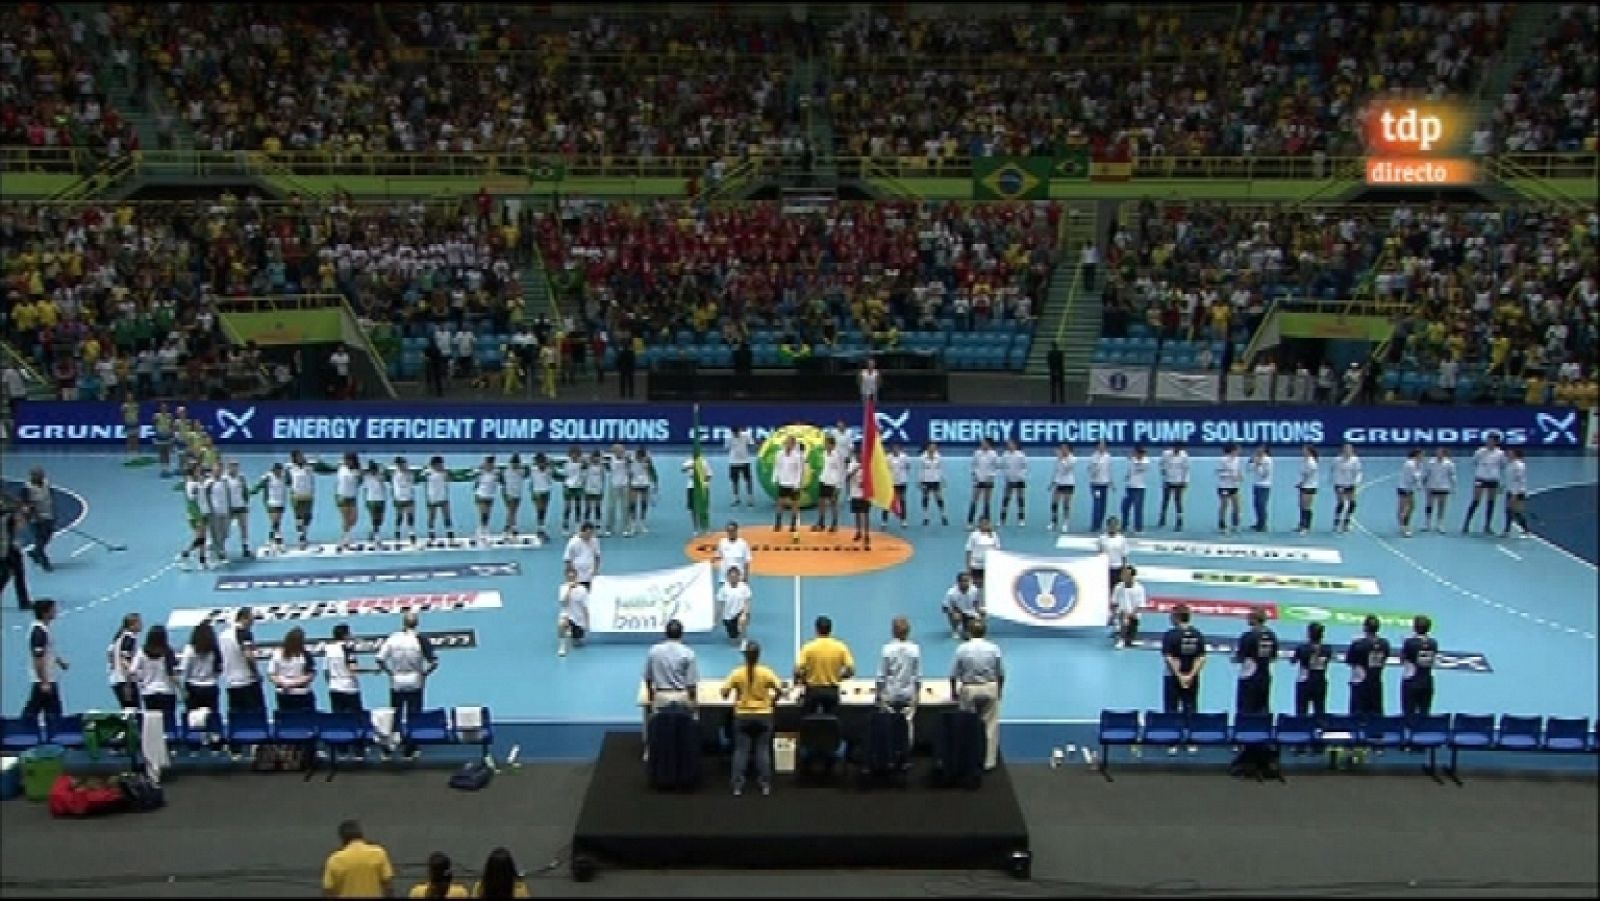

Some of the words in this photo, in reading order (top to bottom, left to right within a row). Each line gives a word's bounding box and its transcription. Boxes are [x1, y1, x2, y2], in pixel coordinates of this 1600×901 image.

[272, 417, 360, 440] ENERGY
[365, 417, 474, 440] EFFICIENT
[480, 418, 540, 440] PUMP
[548, 418, 670, 441] SOLUTIONS
[928, 419, 1013, 442] ENERGY
[1018, 420, 1128, 443] EFFICIENT
[1133, 420, 1195, 443] PUMP
[1200, 421, 1325, 443] SOLUTIONS
[1343, 427, 1528, 443] GRUNDFOS
